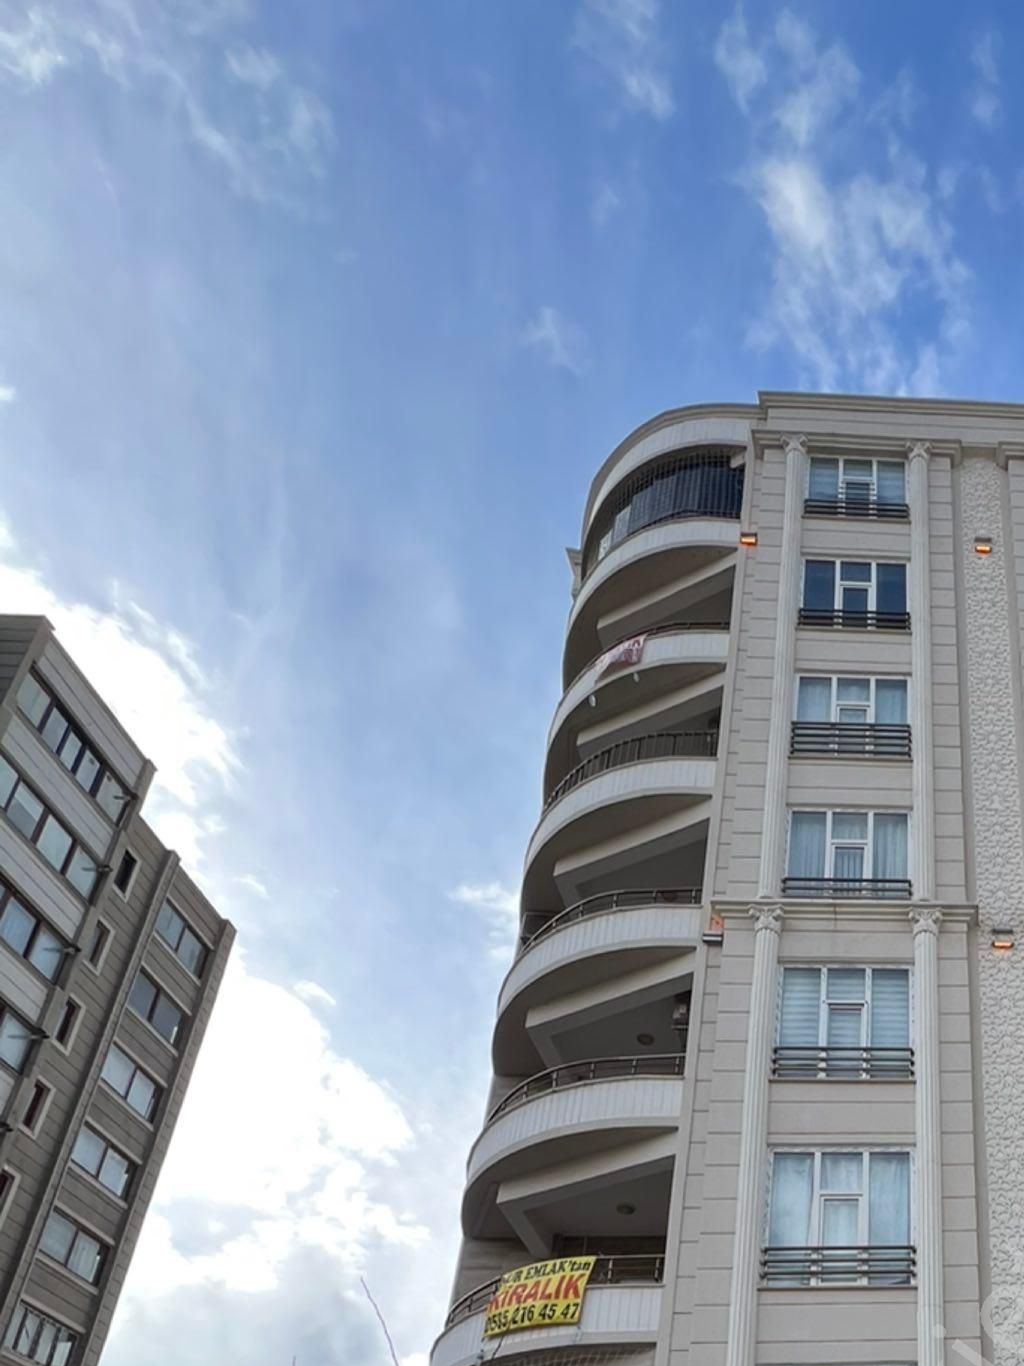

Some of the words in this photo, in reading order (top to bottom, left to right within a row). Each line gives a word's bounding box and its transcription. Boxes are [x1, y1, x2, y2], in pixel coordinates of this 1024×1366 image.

[486, 1273, 586, 1314] KİRALIK
[539, 1303, 556, 1320] 45
[560, 1303, 580, 1319] 47
